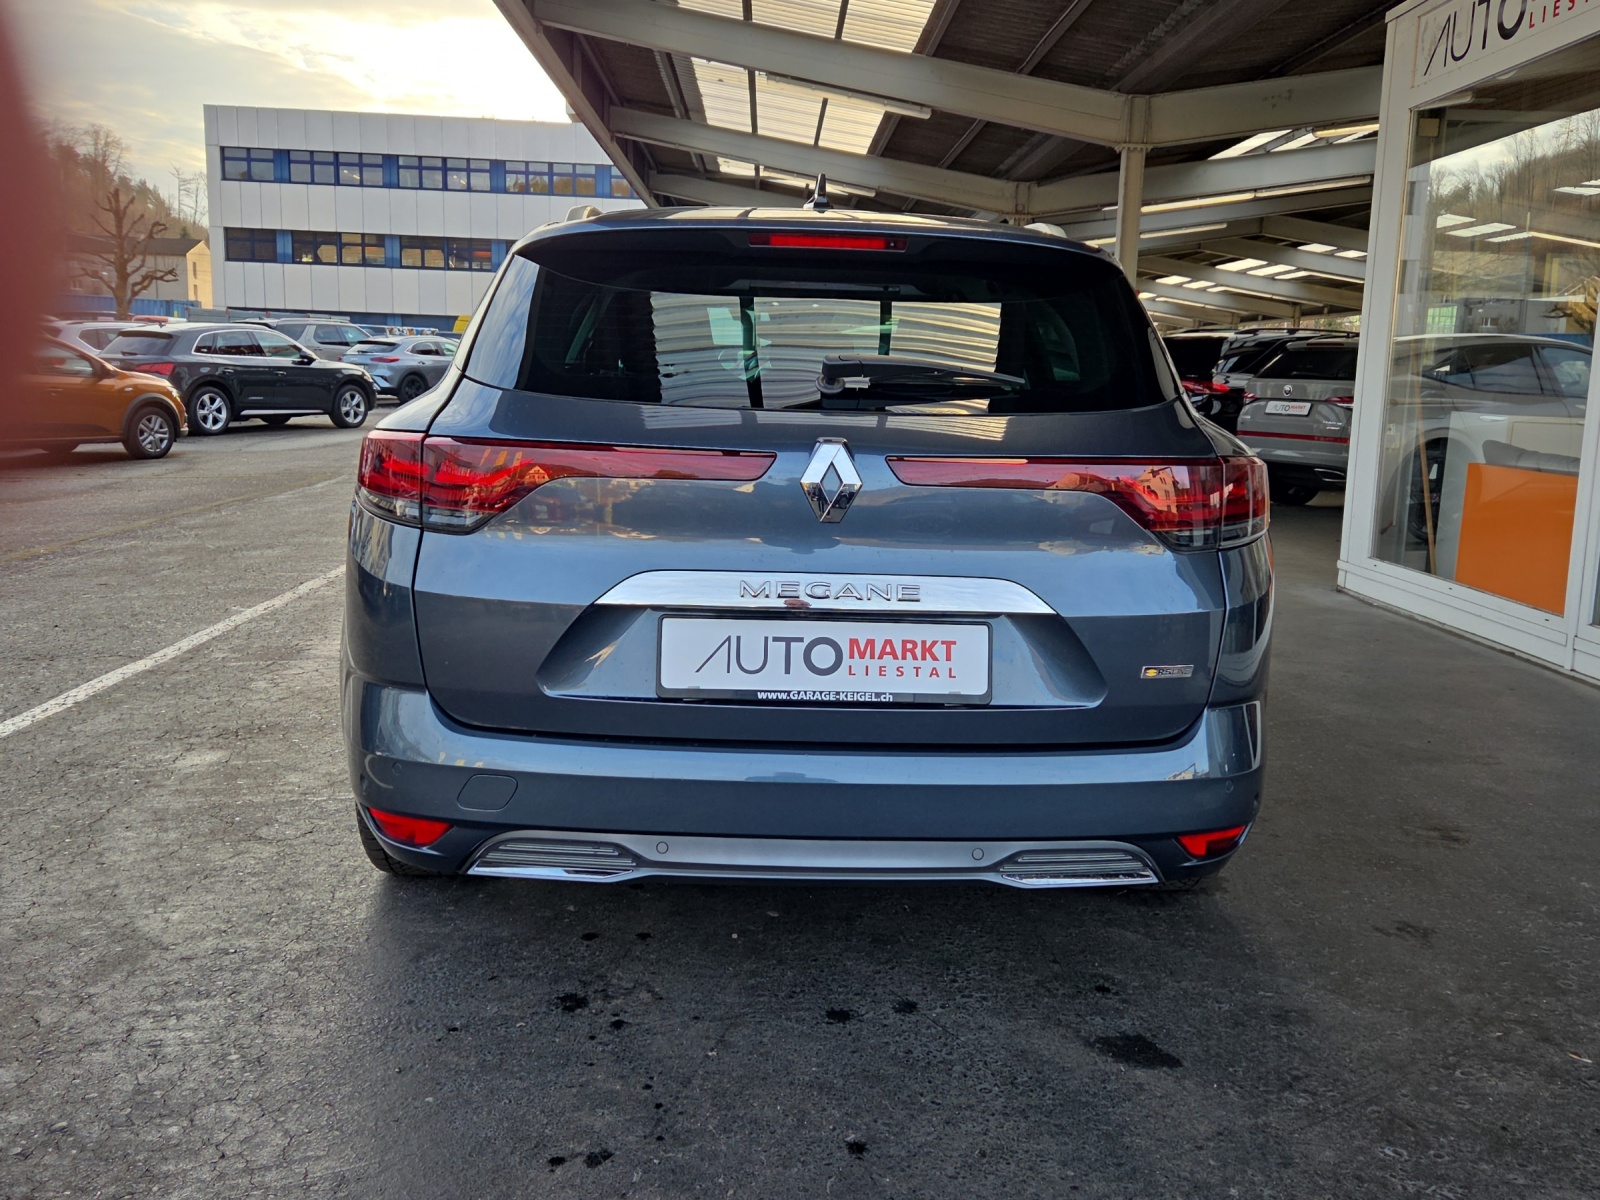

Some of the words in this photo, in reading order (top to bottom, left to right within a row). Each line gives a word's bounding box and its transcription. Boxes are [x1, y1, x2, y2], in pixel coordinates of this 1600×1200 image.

[1529, 0, 1589, 28] LIES
[1424, 0, 1527, 76] AUTO
[739, 580, 921, 602] MEGANE
[694, 634, 844, 676] AUTO
[848, 637, 957, 662] MARKT
[848, 664, 957, 679] LIESTAL
[757, 690, 893, 703] www.GARAGE-KEIGEL.ch
